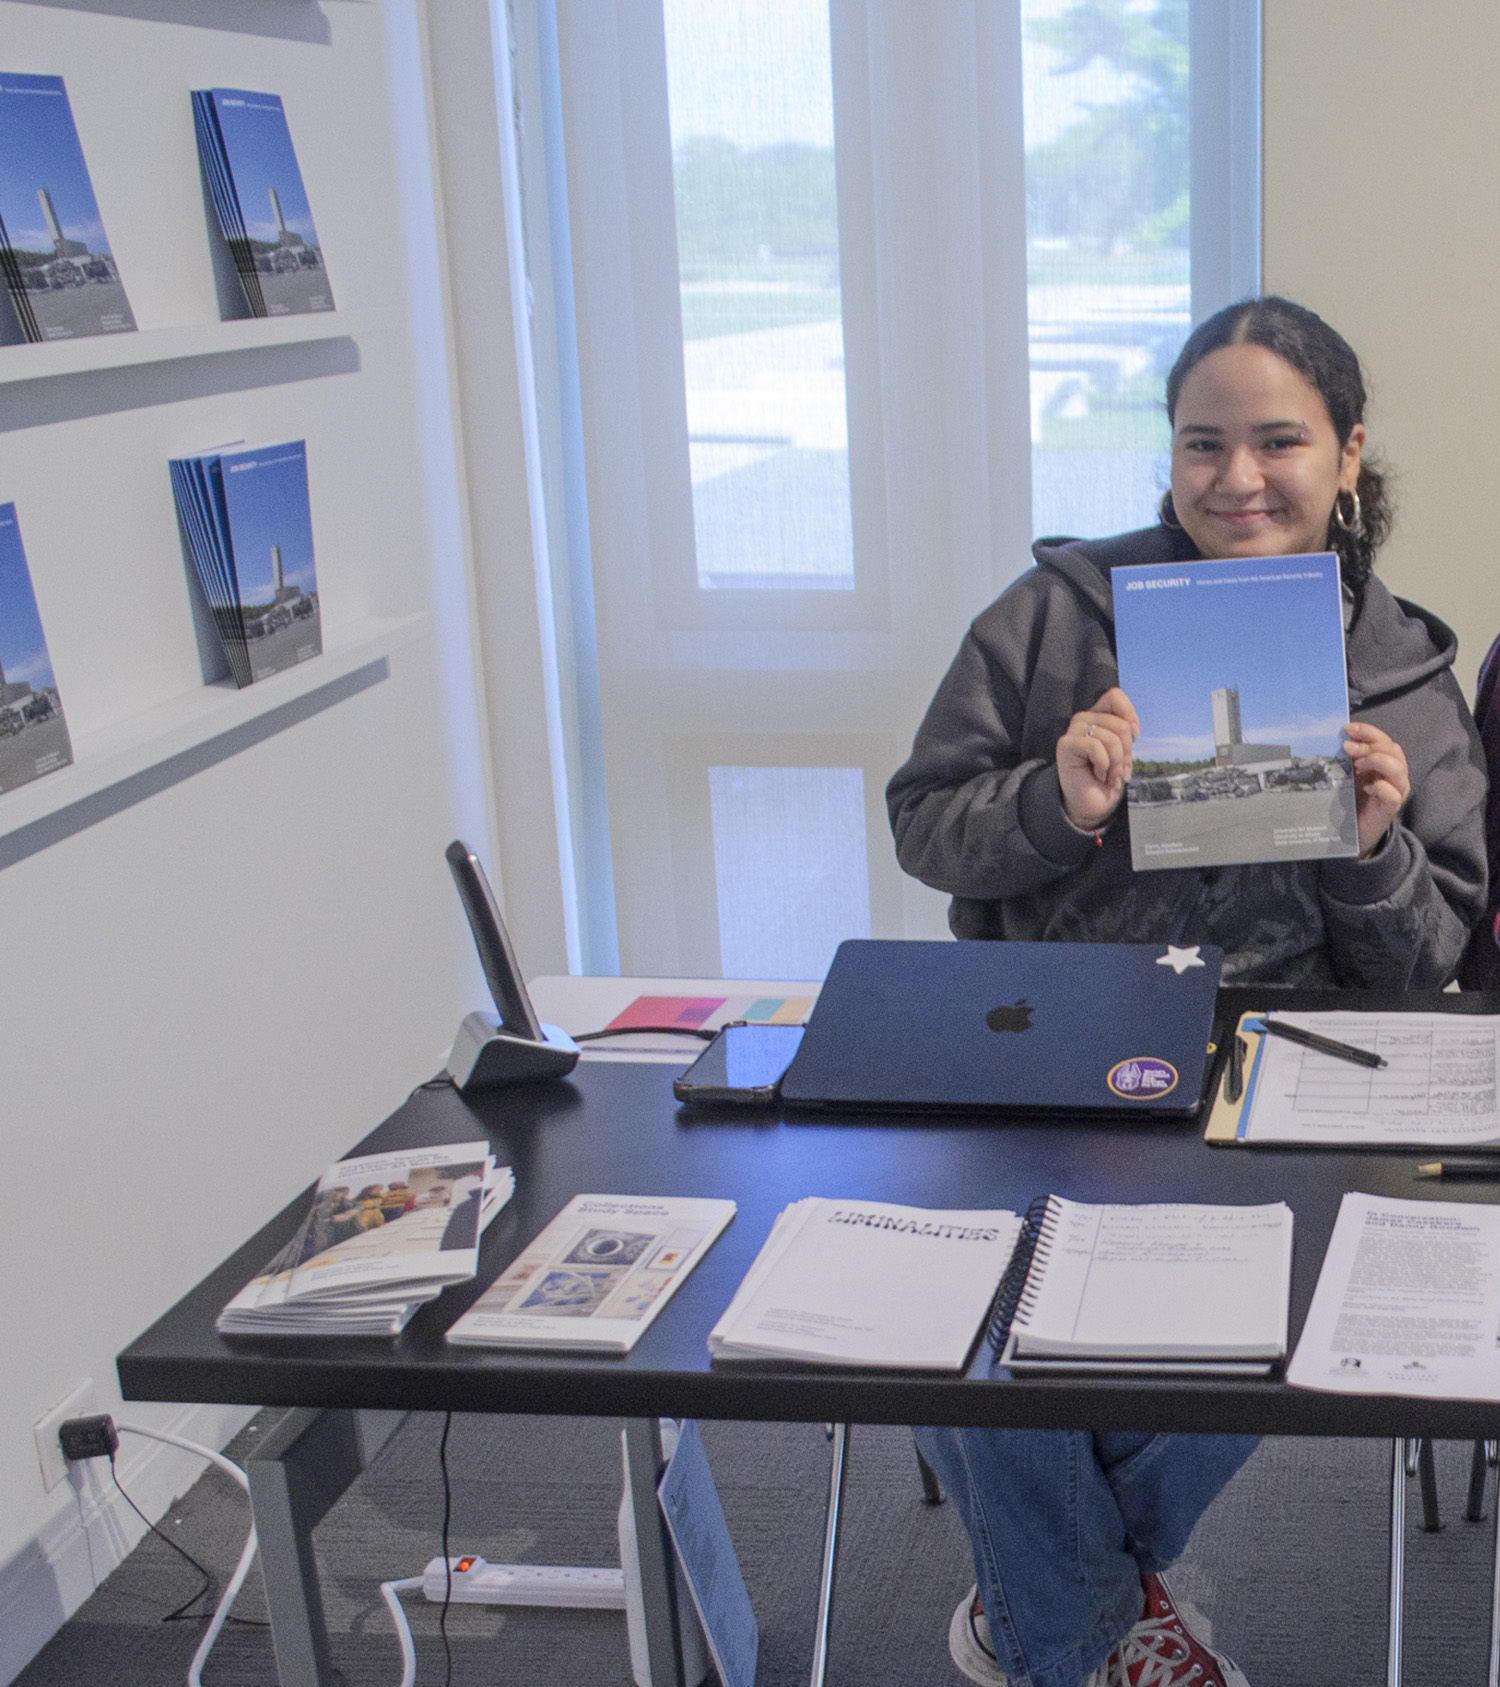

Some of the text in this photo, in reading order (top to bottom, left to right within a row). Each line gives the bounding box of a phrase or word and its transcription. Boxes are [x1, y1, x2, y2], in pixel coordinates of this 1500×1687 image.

[1125, 577, 1191, 591] JOB SECURITY
[578, 1207, 669, 1217] Study Space
[582, 1202, 664, 1210] Collections
[828, 1211, 999, 1241] LIMINALITIES
